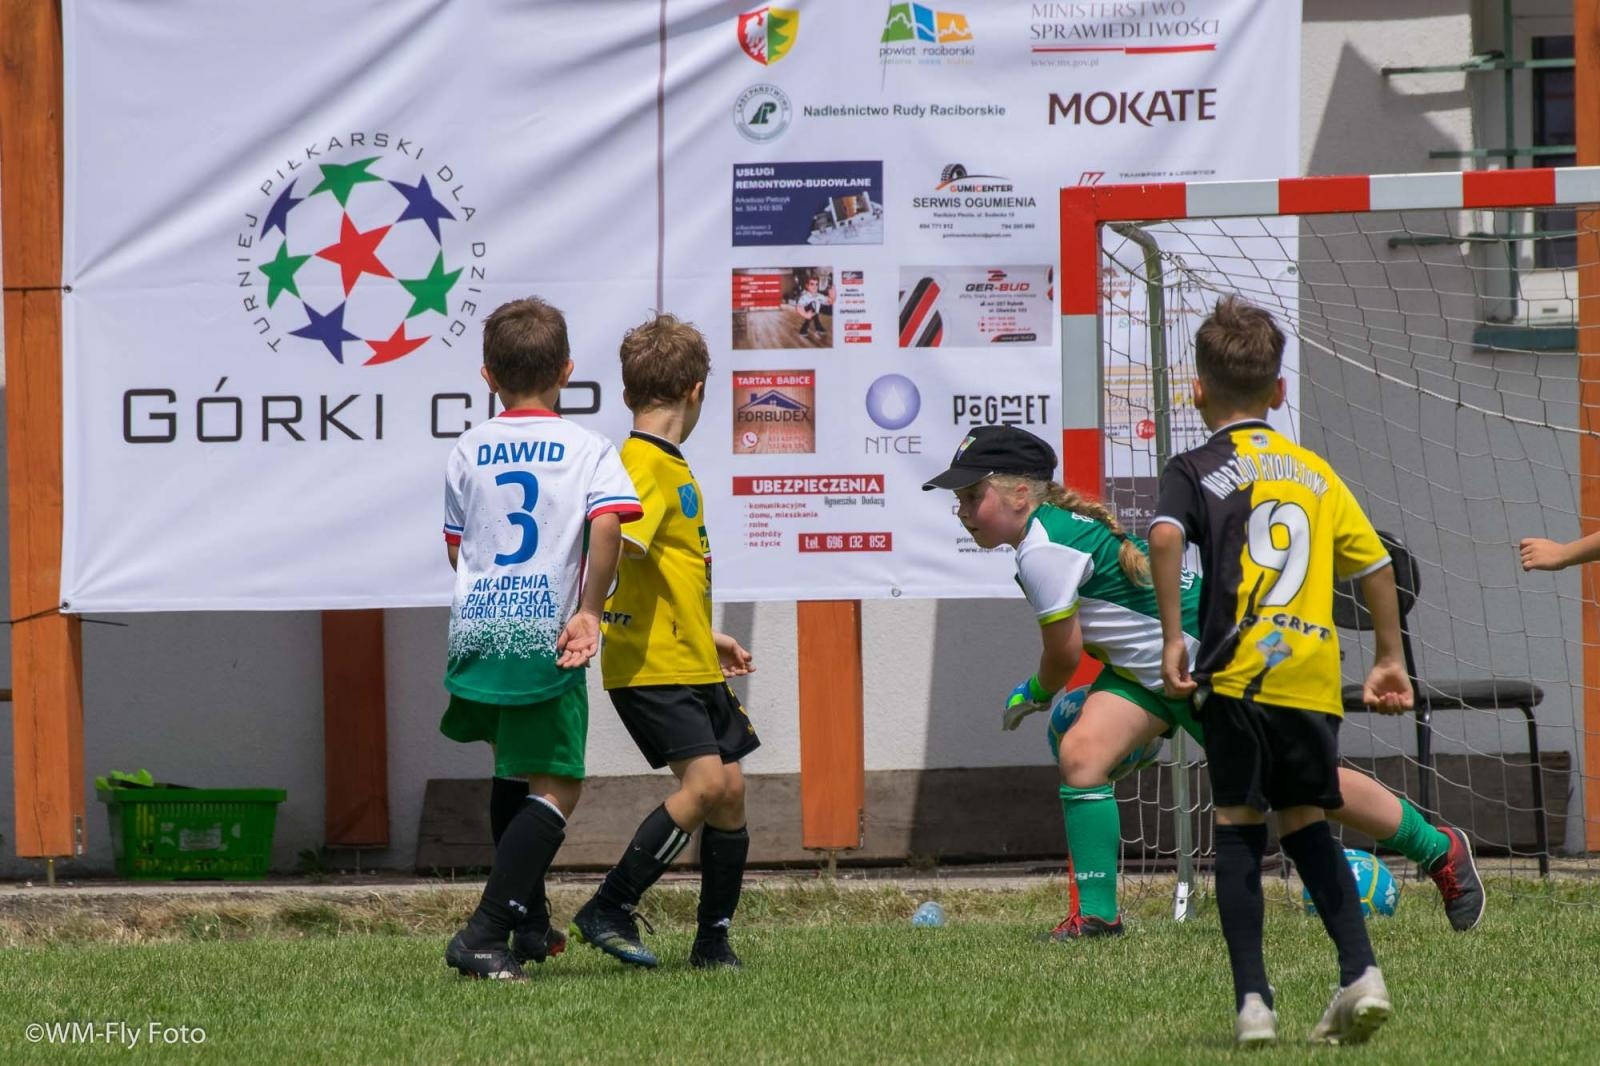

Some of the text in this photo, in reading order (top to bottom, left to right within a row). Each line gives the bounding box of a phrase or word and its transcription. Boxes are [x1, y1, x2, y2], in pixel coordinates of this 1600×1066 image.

[1031, 1, 1186, 19] MINISTERSTWO
[1030, 18, 1220, 40] SPRAWIEDLIWOŚCI
[879, 44, 975, 57] powiat raciborski
[803, 103, 1006, 118] Nadleśnictwo Rudy Raciborskie
[1048, 88, 1217, 127] MOKATE
[735, 167, 775, 177] USŁUGI
[1119, 171, 1167, 179] TRANSPORT
[735, 178, 872, 189] REMONTOWO-BUDOWLANE
[950, 184, 1013, 193] GUMICENTER
[912, 196, 1037, 208] SERWIS OGUMIENIA
[236, 132, 487, 353] TURNIEJ PIŁKARSKI DLA DZIECI
[965, 282, 1030, 292] GER-BUD
[737, 376, 811, 385] TARTAK BABICE
[123, 376, 384, 444] GÓRKI
[737, 410, 811, 422] FORBUDEX
[865, 436, 922, 454] NTCE
[477, 441, 565, 466] DAWID
[752, 478, 881, 493] UBEZPIECZENIA
[494, 470, 539, 567] 3
[804, 535, 820, 549] tel.
[869, 534, 886, 548] 852
[1248, 499, 1312, 607] 9
[472, 574, 550, 592] AKADEMIA
[466, 590, 552, 607] PIŁKARSKA
